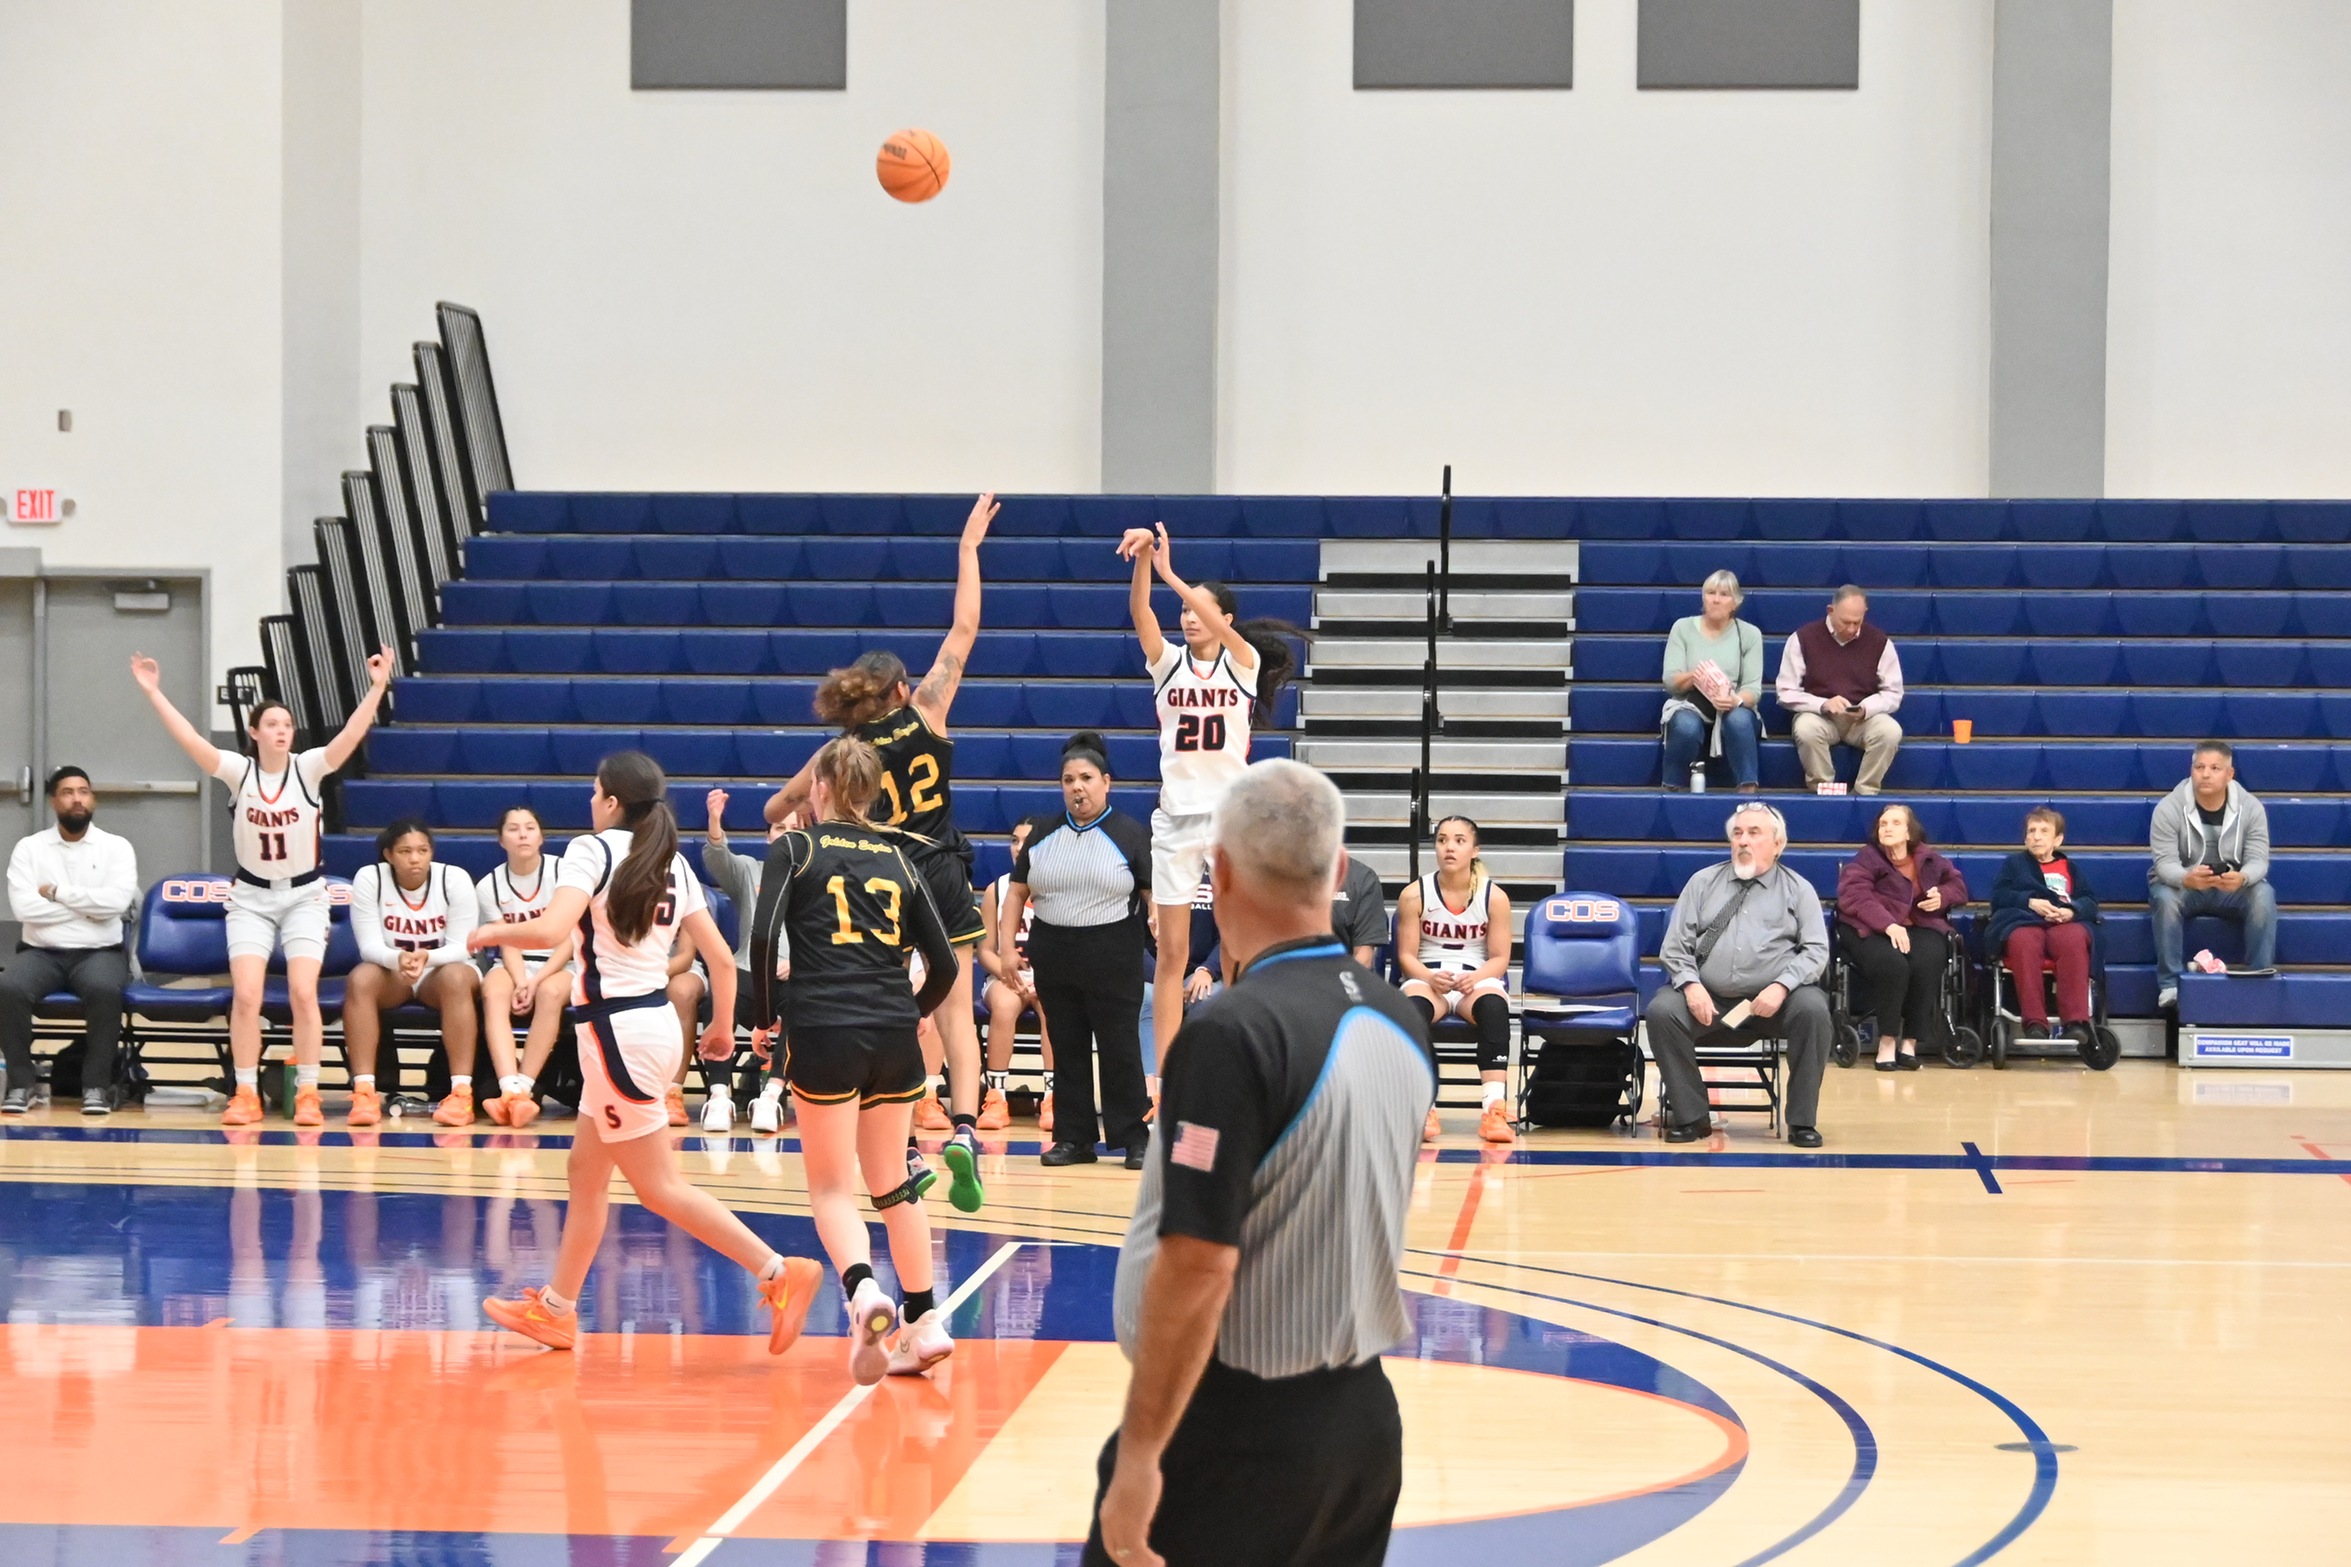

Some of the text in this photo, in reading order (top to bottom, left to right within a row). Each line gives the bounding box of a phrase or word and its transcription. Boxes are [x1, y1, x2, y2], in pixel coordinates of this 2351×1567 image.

[17, 489, 54, 519] EXIT
[1167, 687, 1239, 708] GIANTS
[1174, 713, 1227, 752] 20
[880, 753, 944, 826] 12
[246, 806, 300, 828] GIANTS
[258, 832, 288, 862] 11
[162, 880, 232, 903] COS
[503, 906, 547, 925] GIAN
[826, 875, 902, 946] 13
[1546, 900, 1620, 923] COS
[383, 915, 447, 935] GIANTS
[1421, 920, 1487, 940] GIANTS
[604, 1105, 622, 1129] S
